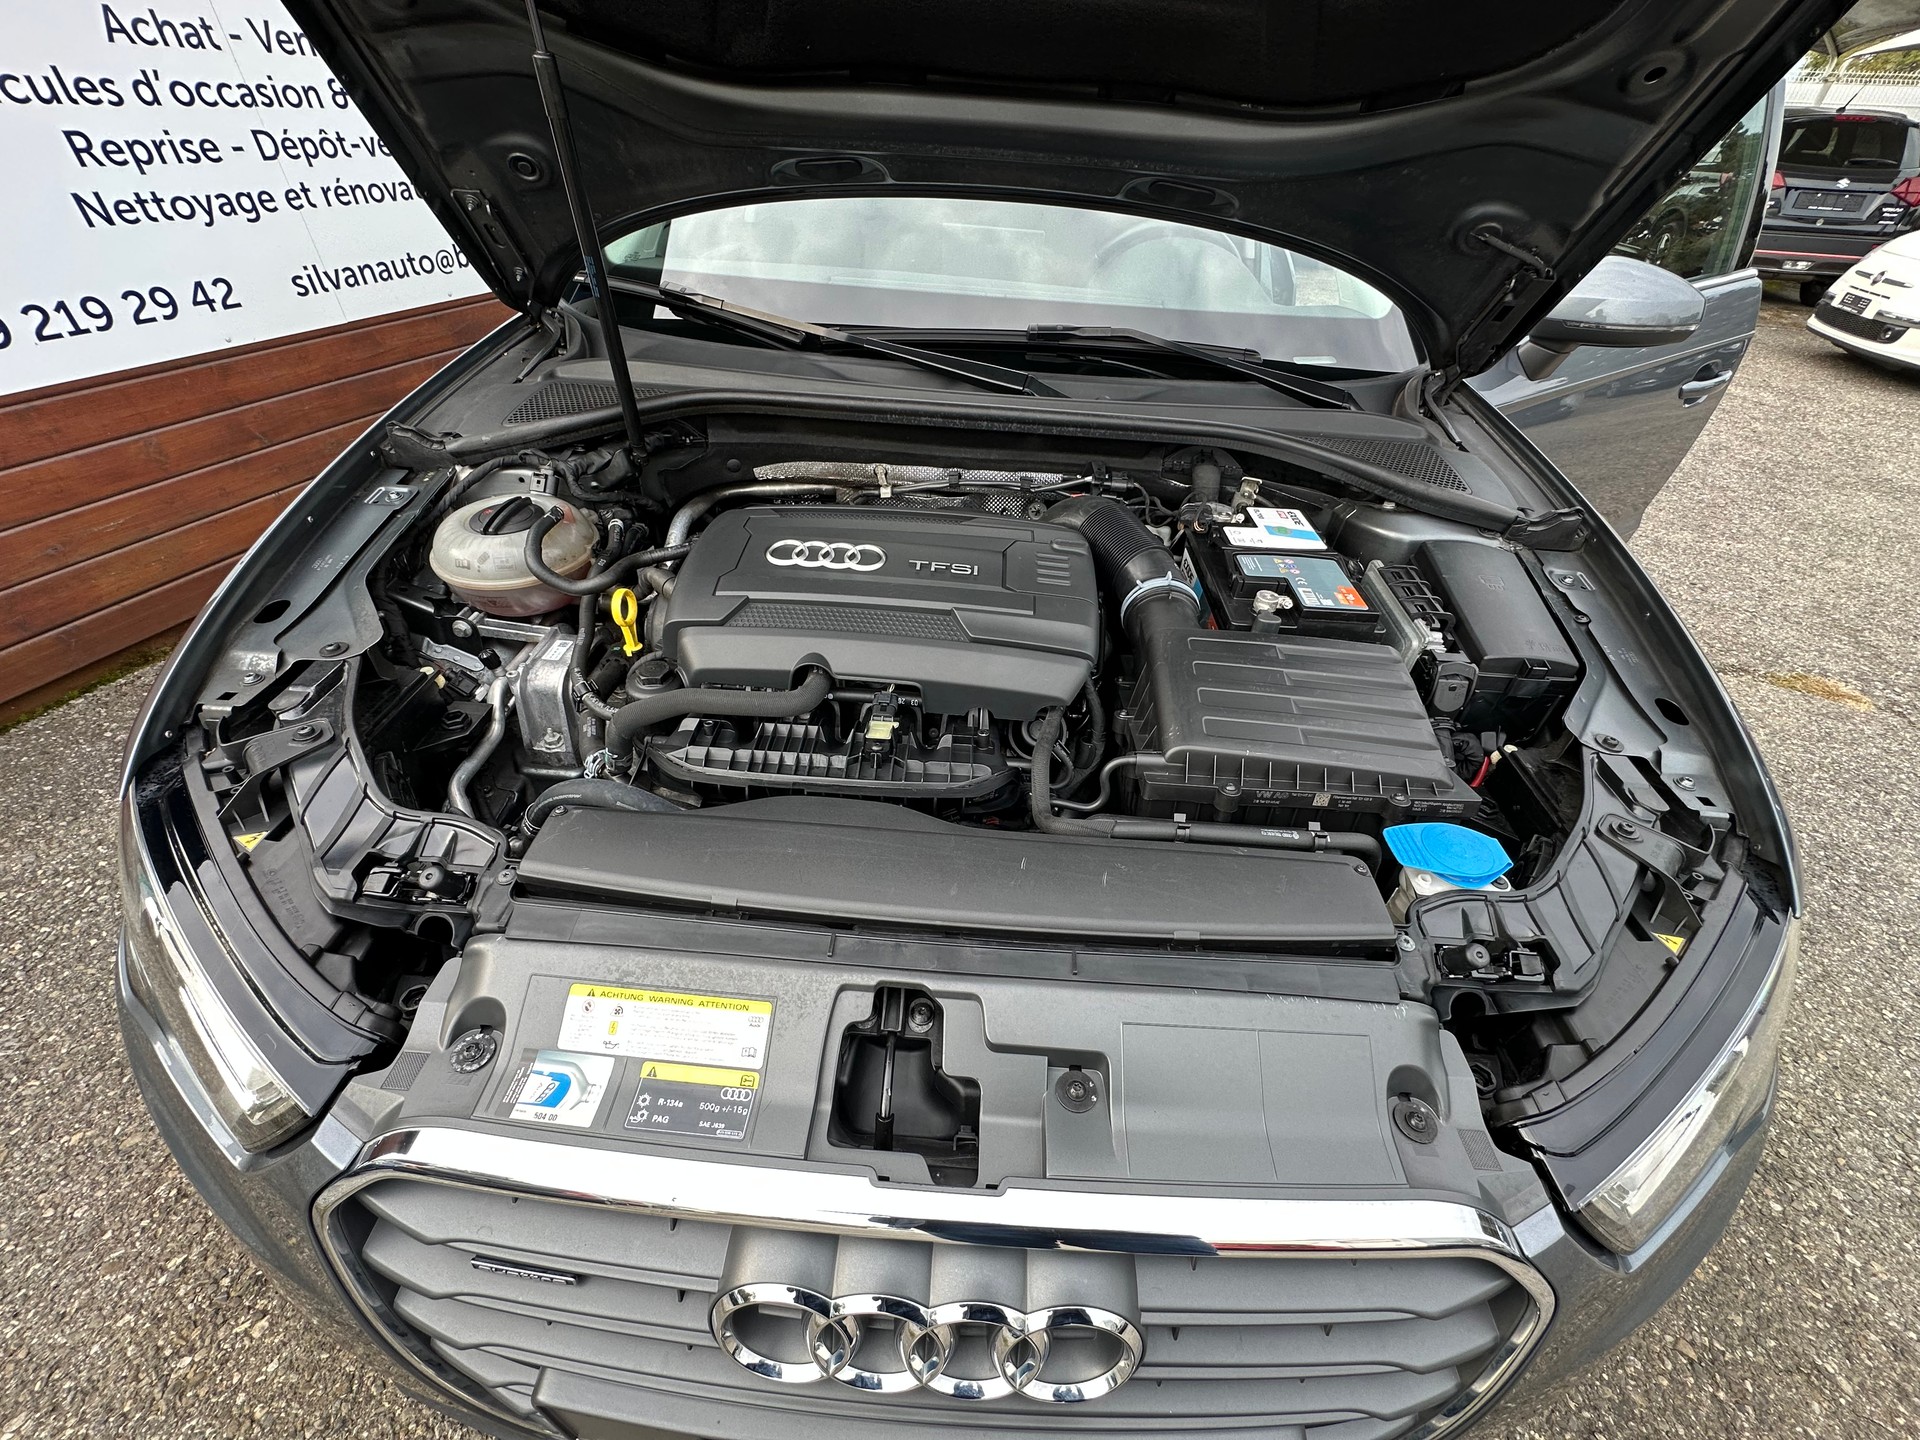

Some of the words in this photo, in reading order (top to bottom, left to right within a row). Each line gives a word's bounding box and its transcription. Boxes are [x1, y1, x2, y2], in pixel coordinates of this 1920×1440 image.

[101, 4, 222, 51] Achat
[245, 17, 317, 57] Ven
[0, 64, 125, 107] cules
[62, 129, 223, 176] Reprise
[71, 187, 279, 228] Nettoyage
[284, 181, 318, 211] et
[291, 243, 470, 297] silvanauto@b
[20, 295, 114, 343] 219
[121, 286, 179, 326] 29
[193, 277, 243, 314] 42
[908, 559, 979, 576] TFSI
[600, 991, 644, 1002] ACHTUNG
[648, 995, 694, 1006] WARNING
[698, 1000, 750, 1012] ATTENTION
[651, 1114, 670, 1124] PAG
[657, 1098, 684, 1108] R-134a
[699, 1101, 721, 1113] 500g
